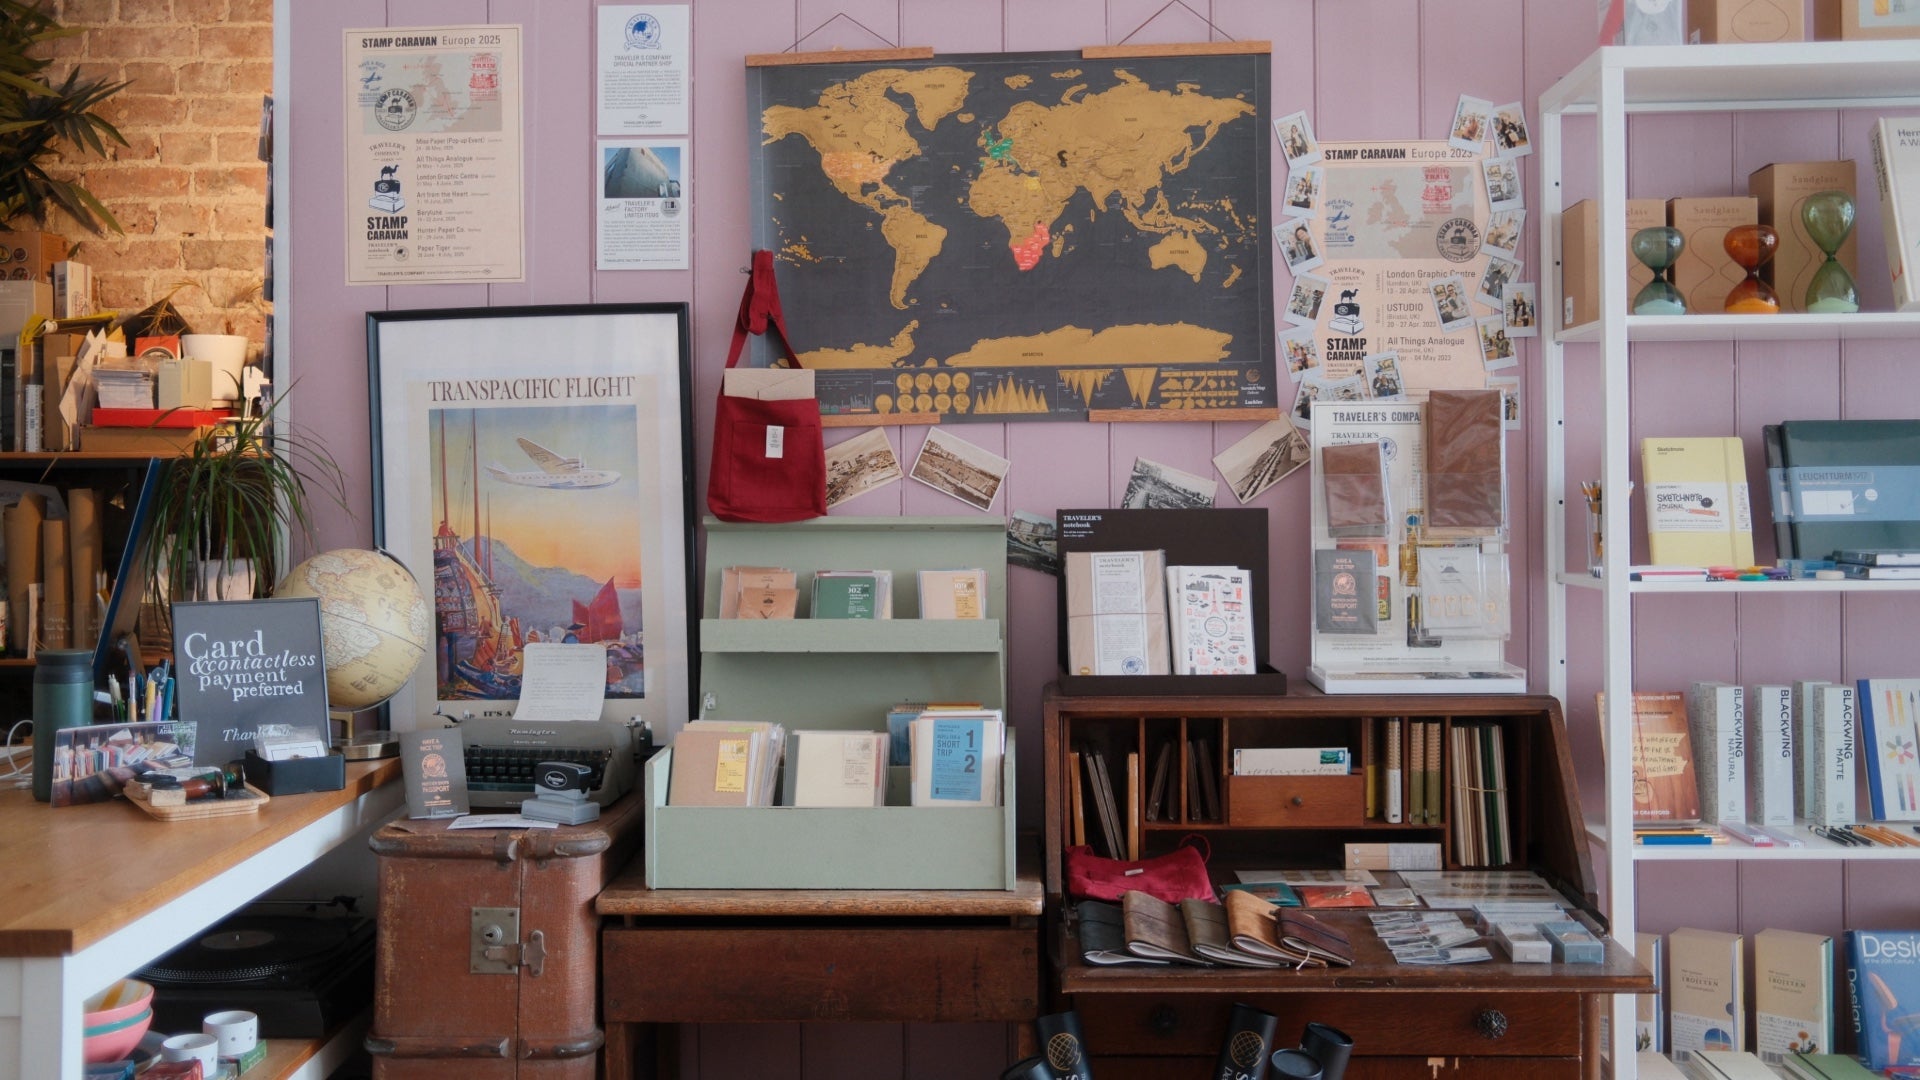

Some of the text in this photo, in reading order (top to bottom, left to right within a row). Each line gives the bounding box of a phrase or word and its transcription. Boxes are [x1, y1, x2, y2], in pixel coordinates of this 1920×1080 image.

[362, 35, 501, 48] STAMP CARAVAN Europe 2025
[1325, 148, 1473, 160] STAMP CARAVAN Europe 2023
[1792, 176, 1838, 185] Sandglass
[1694, 206, 1740, 215] Sandglass
[368, 216, 408, 230] STAMP
[1439, 220, 1479, 239] STAMP CARAVAN
[368, 230, 408, 240] CARAVAN
[1329, 268, 1365, 276] TRAVELER'S
[1387, 270, 1415, 278] London
[1418, 270, 1447, 279] Graphic
[1327, 338, 1367, 350] STAMP
[1388, 337, 1464, 346] All Things Analogue
[1327, 352, 1367, 360] CARAVAN
[428, 376, 636, 402] TRANSPACIFIC FLIGHT
[1333, 411, 1421, 422] TRAVELER'S COMPA
[1799, 472, 1868, 480] LEUCHTTURM1917
[184, 630, 266, 660] Card
[200, 668, 287, 691] payment
[232, 681, 304, 701] preferred
[1734, 688, 1744, 758] BLACKWING
[1780, 690, 1791, 758] BLACKWING
[1843, 689, 1853, 760] BLACKWING
[937, 740, 960, 748] SHORT
[966, 729, 974, 748] 1
[937, 749, 952, 757] TRIP
[964, 754, 976, 773] 2
[1836, 748, 1844, 781] MATTE
[1848, 969, 1861, 1033] Design
